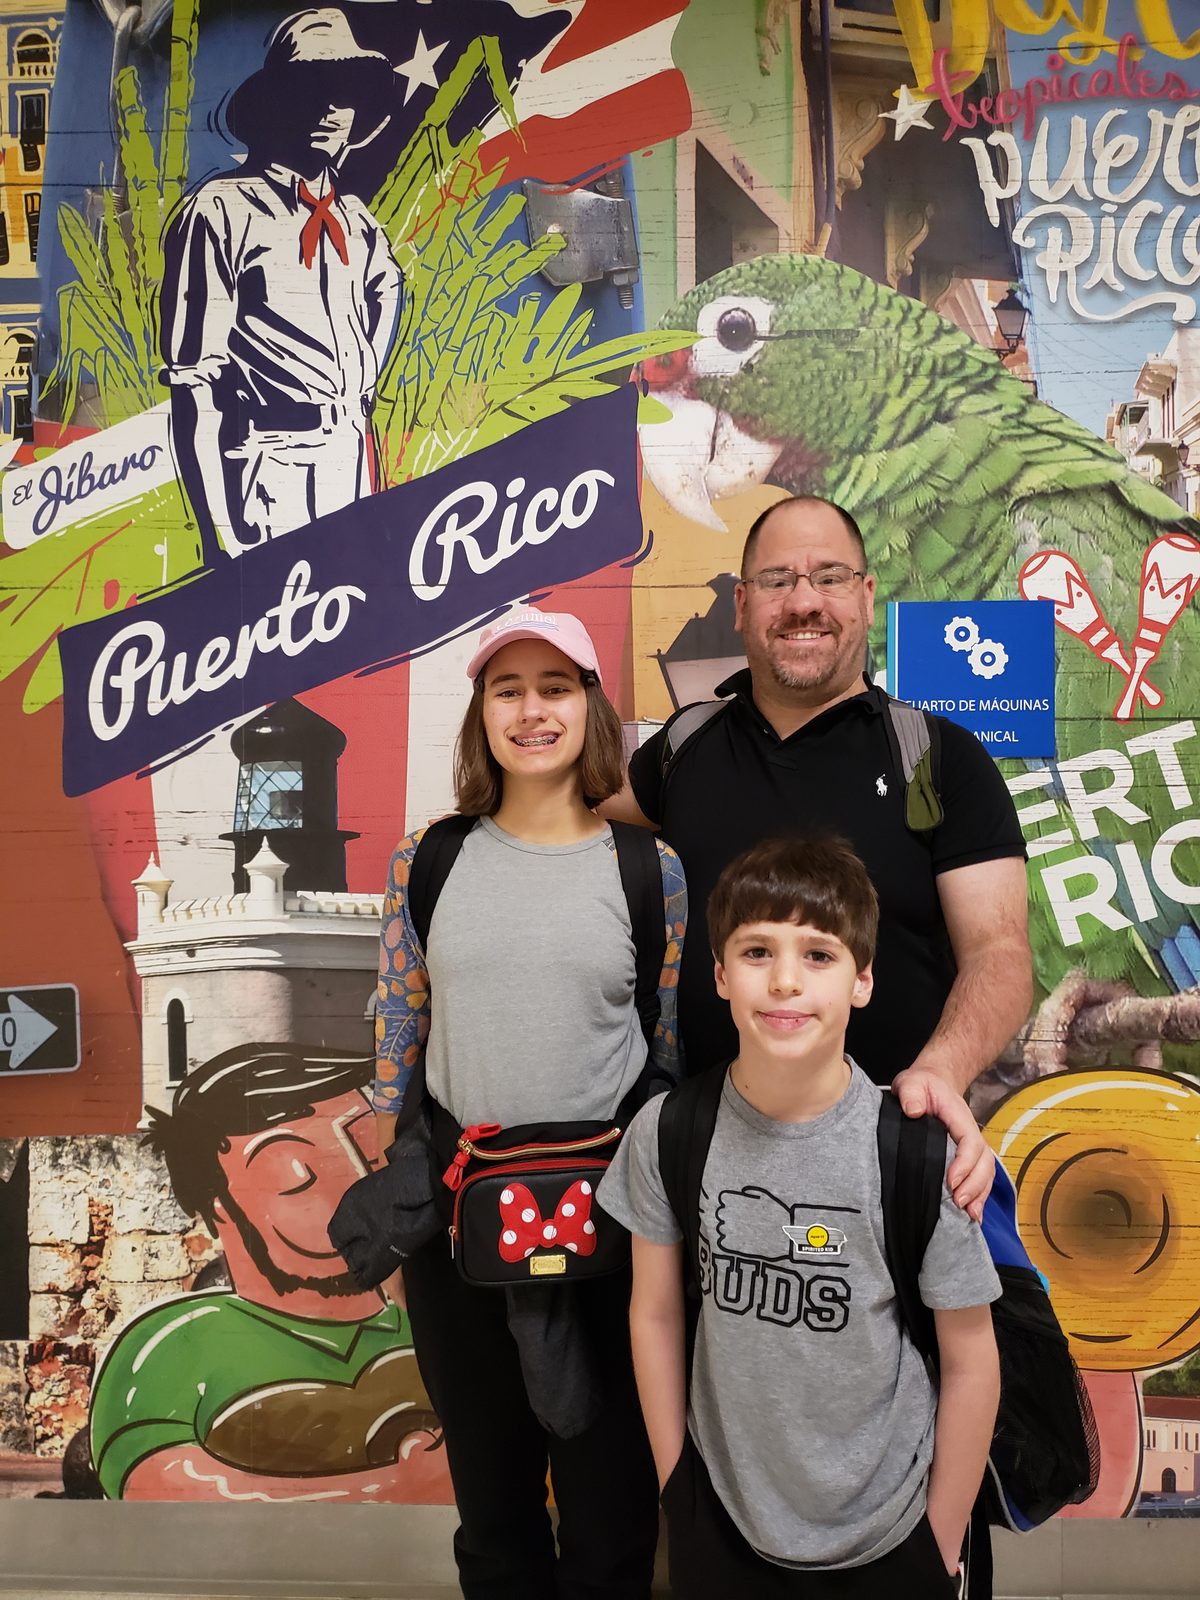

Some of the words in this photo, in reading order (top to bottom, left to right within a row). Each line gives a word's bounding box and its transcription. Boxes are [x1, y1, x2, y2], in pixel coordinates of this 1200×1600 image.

[12, 479, 33, 506] El
[32, 445, 163, 536] Jíbaro
[88, 559, 366, 741] Puerto
[408, 469, 616, 601] Rico
[958, 700, 976, 711] DE
[979, 697, 1049, 713] MÁQUINAS
[973, 730, 1019, 742] ANICAL
